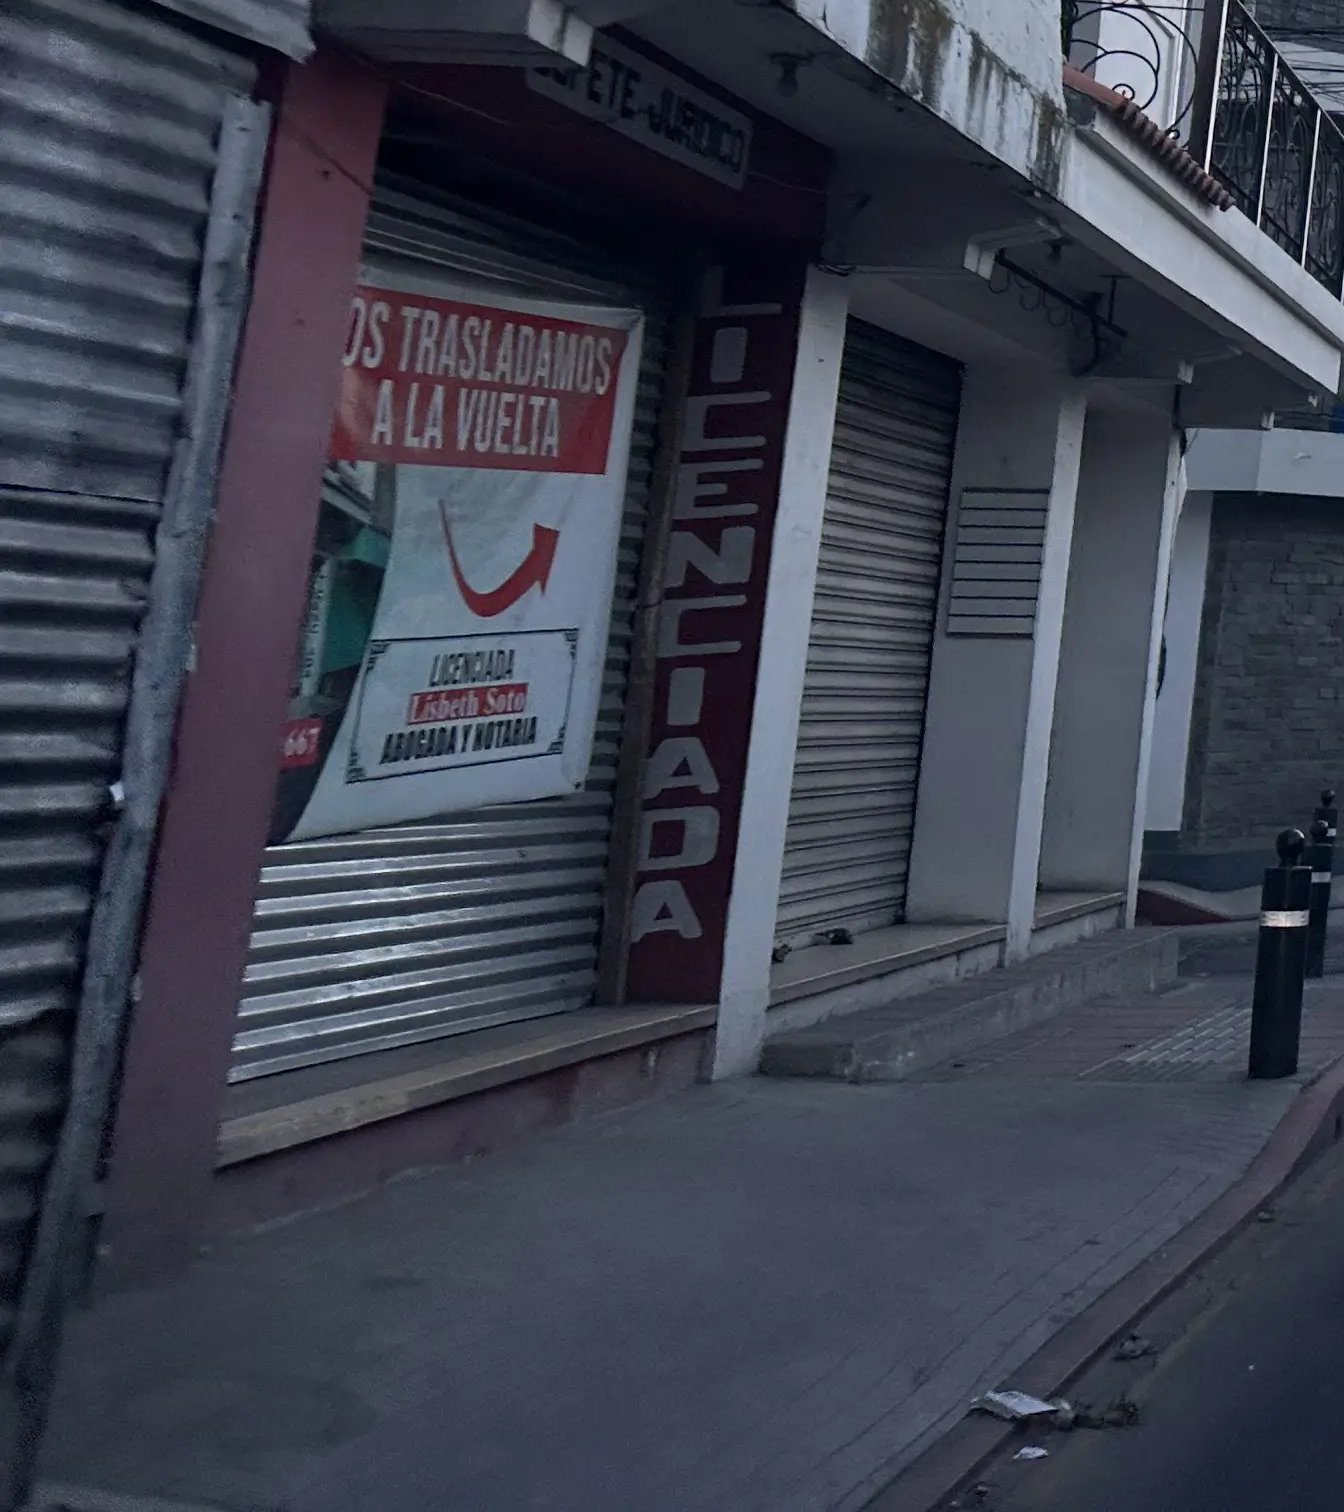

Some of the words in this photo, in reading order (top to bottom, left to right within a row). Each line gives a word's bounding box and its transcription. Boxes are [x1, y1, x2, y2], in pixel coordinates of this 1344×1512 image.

[341, 297, 390, 368] OS
[399, 305, 613, 395] TRASLADAMOS
[372, 379, 395, 446] A
[403, 382, 445, 449] LA
[457, 387, 559, 458] VUELTA
[631, 265, 784, 942] LICENCIADA
[429, 649, 515, 687] LICENCIADA
[409, 689, 479, 722] Lisbeth
[483, 687, 526, 715] Soto
[379, 725, 456, 764] ABOGADA
[461, 724, 472, 752] Y
[472, 716, 538, 751] NOTARIA
